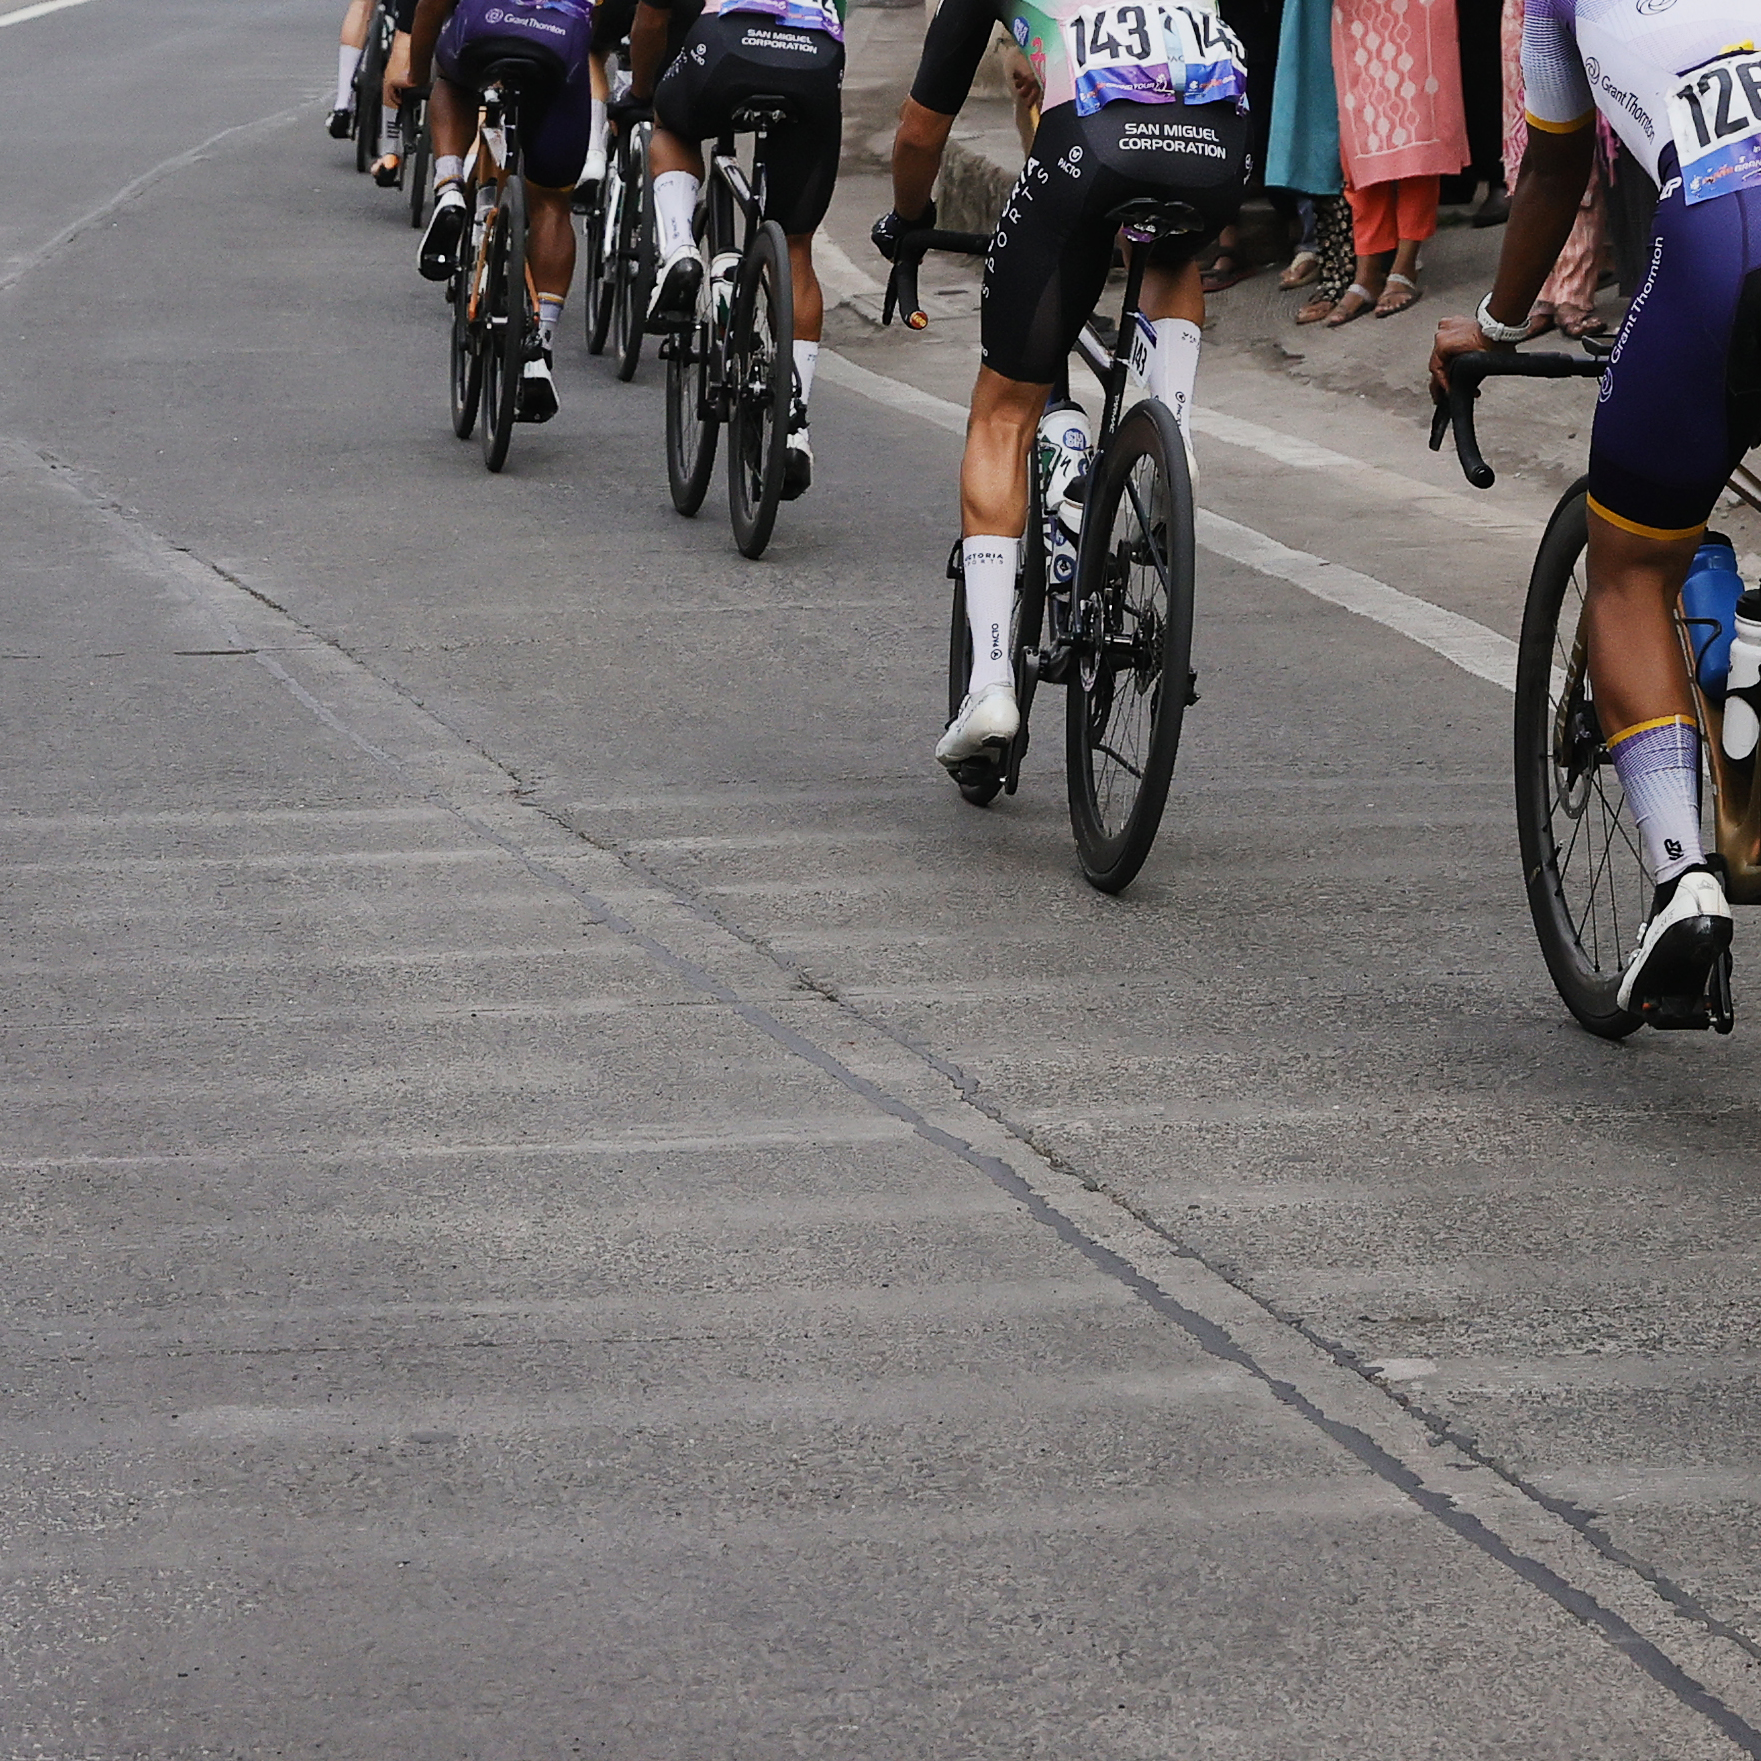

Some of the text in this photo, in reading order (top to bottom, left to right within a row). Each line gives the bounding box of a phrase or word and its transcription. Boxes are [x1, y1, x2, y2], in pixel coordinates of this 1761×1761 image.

[504, 13, 530, 26] Grant
[741, 36, 818, 54] CORPORATION
[747, 28, 813, 44] SAN MIGUEL
[1070, 5, 1151, 68] 143
[1601, 75, 1656, 145] Grant Thornton
[1124, 123, 1220, 143] SAN MIGUEL
[1118, 137, 1227, 160] CORPORATION
[1057, 157, 1081, 179] PACTO
[1610, 236, 1665, 364] Grant Thornton
[1131, 336, 1147, 377] 143
